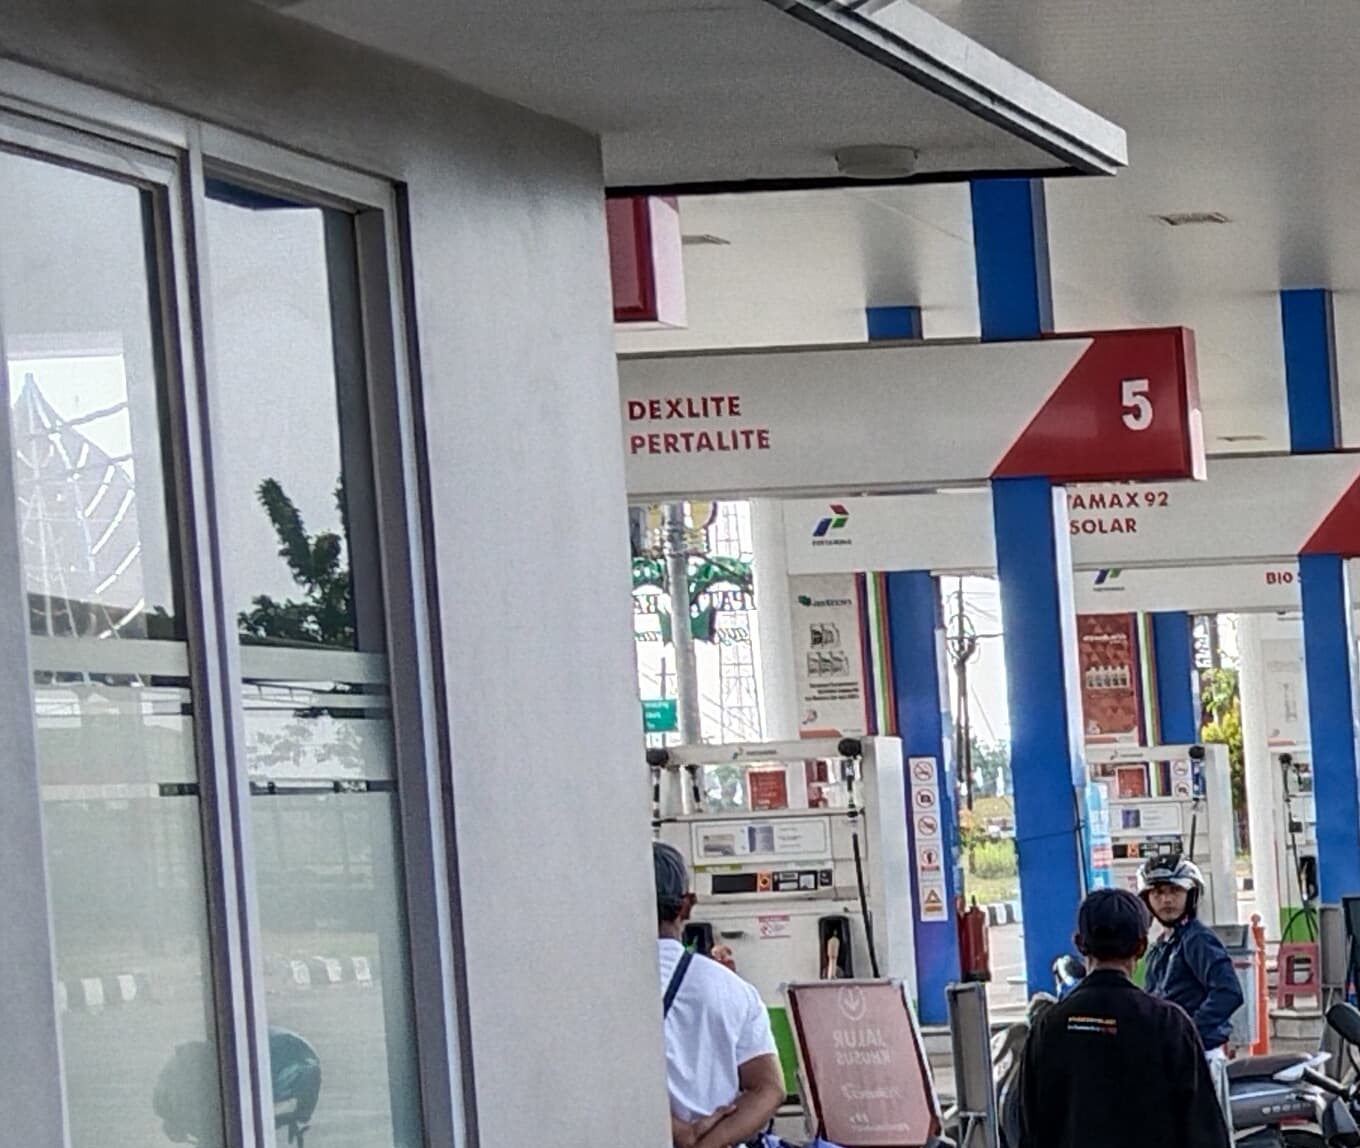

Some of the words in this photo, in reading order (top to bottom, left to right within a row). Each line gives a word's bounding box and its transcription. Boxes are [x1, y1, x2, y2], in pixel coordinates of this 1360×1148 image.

[627, 396, 742, 420] DEXLITE
[1120, 377, 1154, 432] 5
[630, 429, 771, 454] PERTALITE
[1067, 491, 1140, 510] AMAX
[1144, 491, 1169, 507] 92
[1069, 518, 1137, 535] SOLAR
[1265, 571, 1293, 585] BIO
